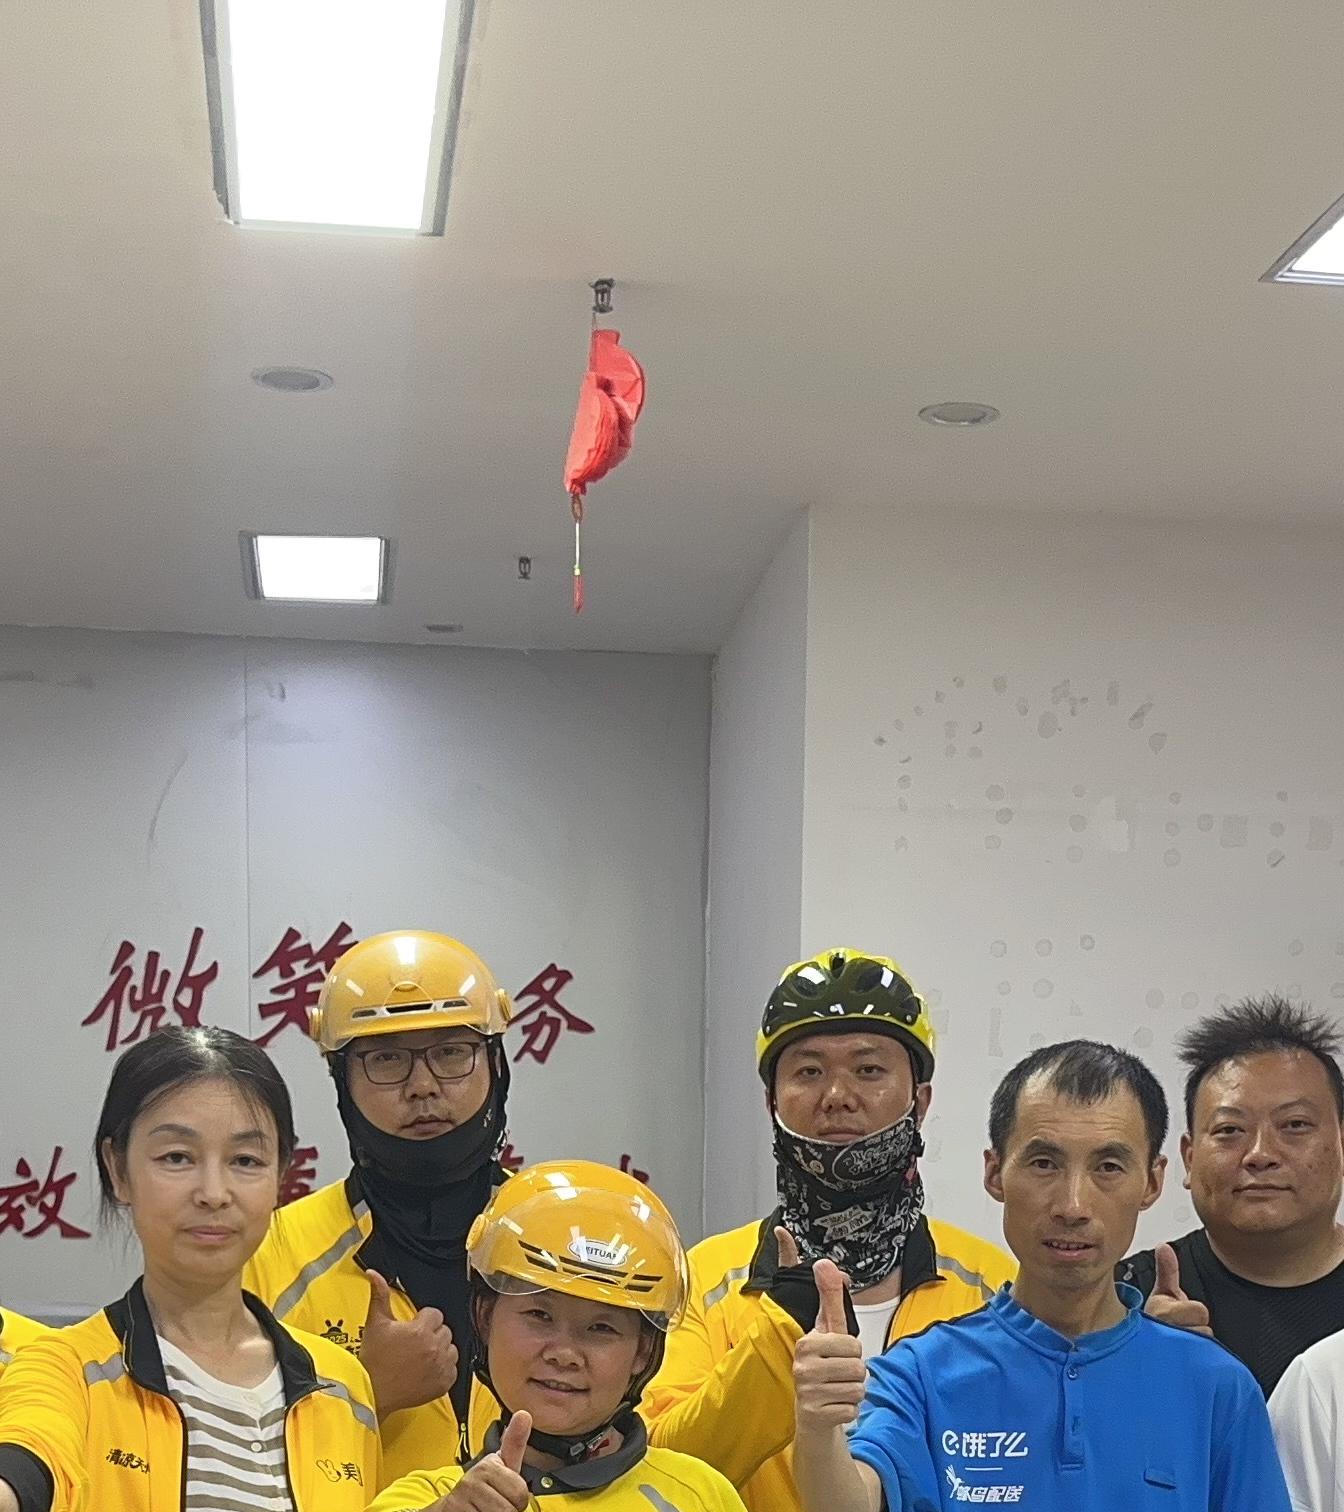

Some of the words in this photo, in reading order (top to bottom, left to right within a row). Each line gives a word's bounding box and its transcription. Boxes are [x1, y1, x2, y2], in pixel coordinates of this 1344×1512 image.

[81, 921, 594, 1063] 微笑务
[962, 1432, 1029, 1458] 饿了么
[956, 1485, 1025, 1503] 蜂鸟配送
